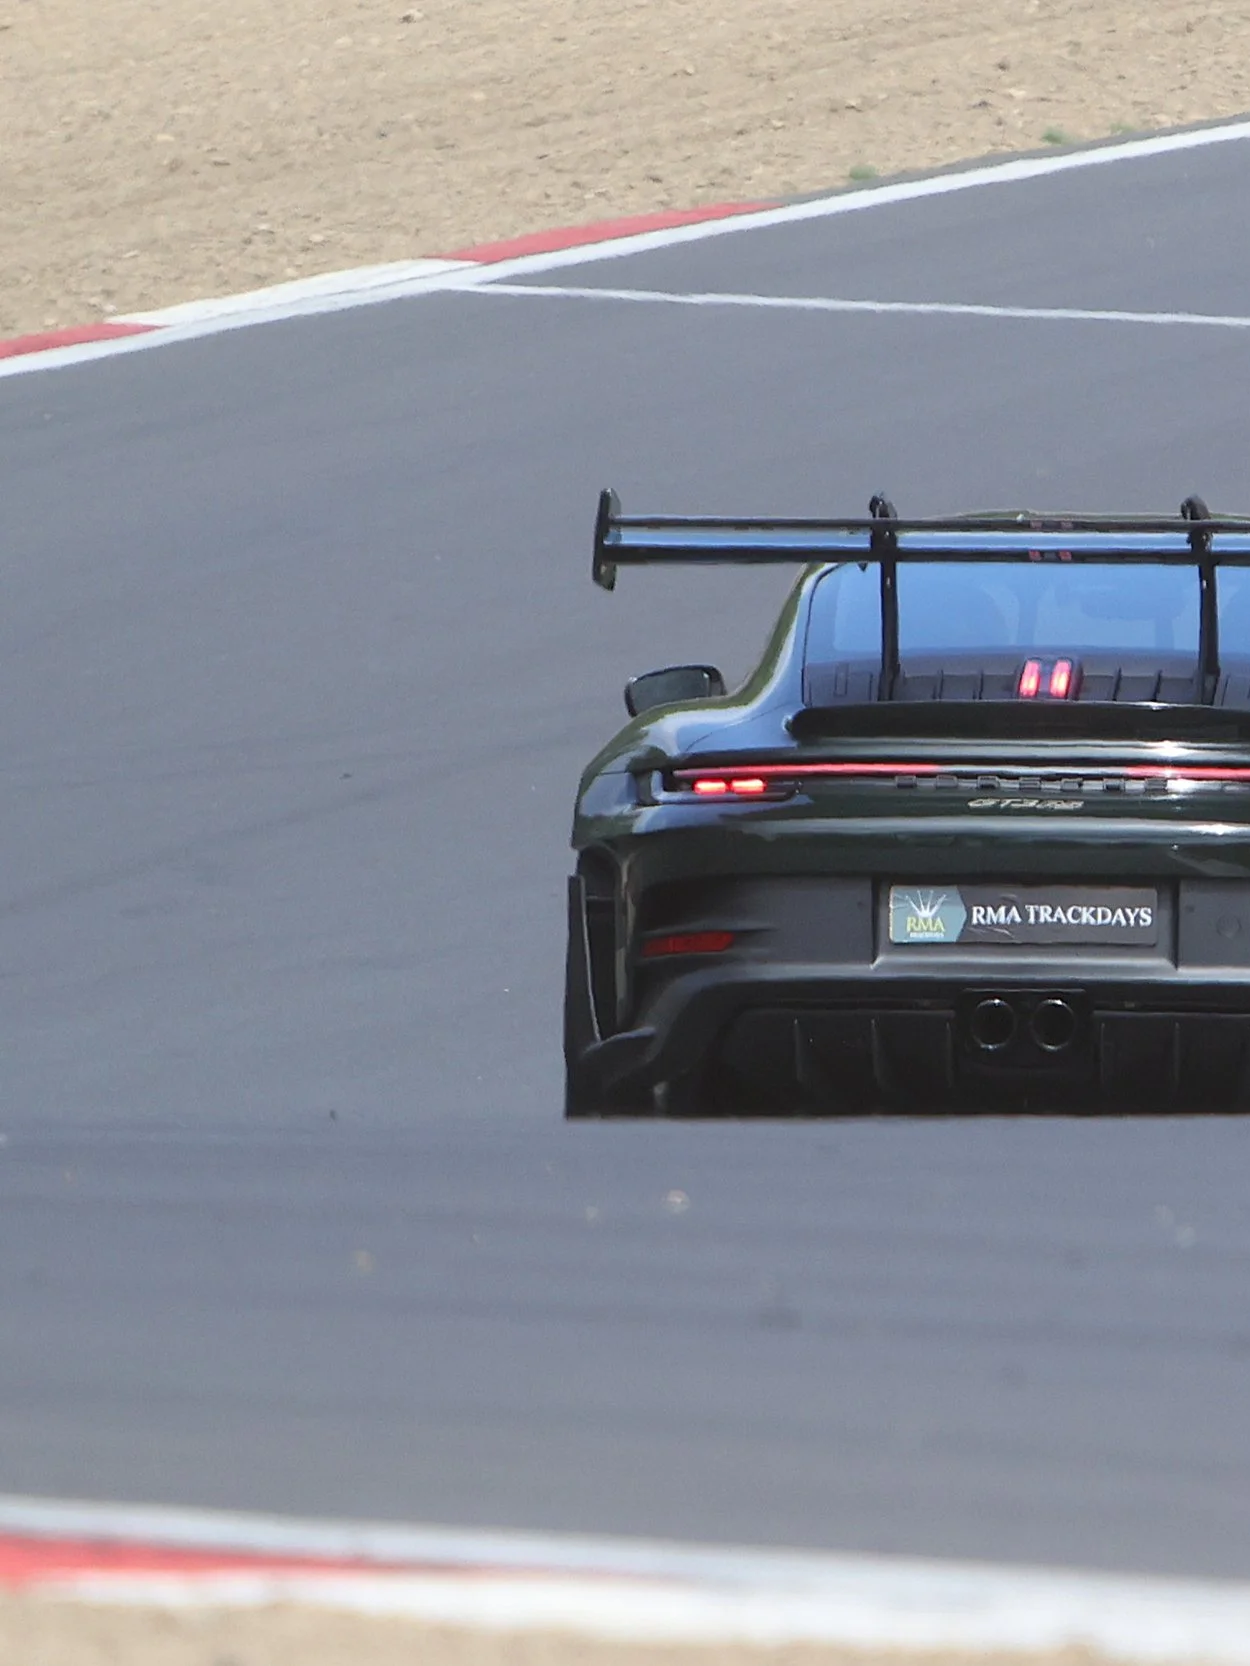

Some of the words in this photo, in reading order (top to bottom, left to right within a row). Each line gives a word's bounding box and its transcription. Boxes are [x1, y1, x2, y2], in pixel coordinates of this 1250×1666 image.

[906, 916, 946, 932] RMA
[971, 905, 1021, 925] RMA
[1025, 904, 1152, 927] TRACKDAYS
